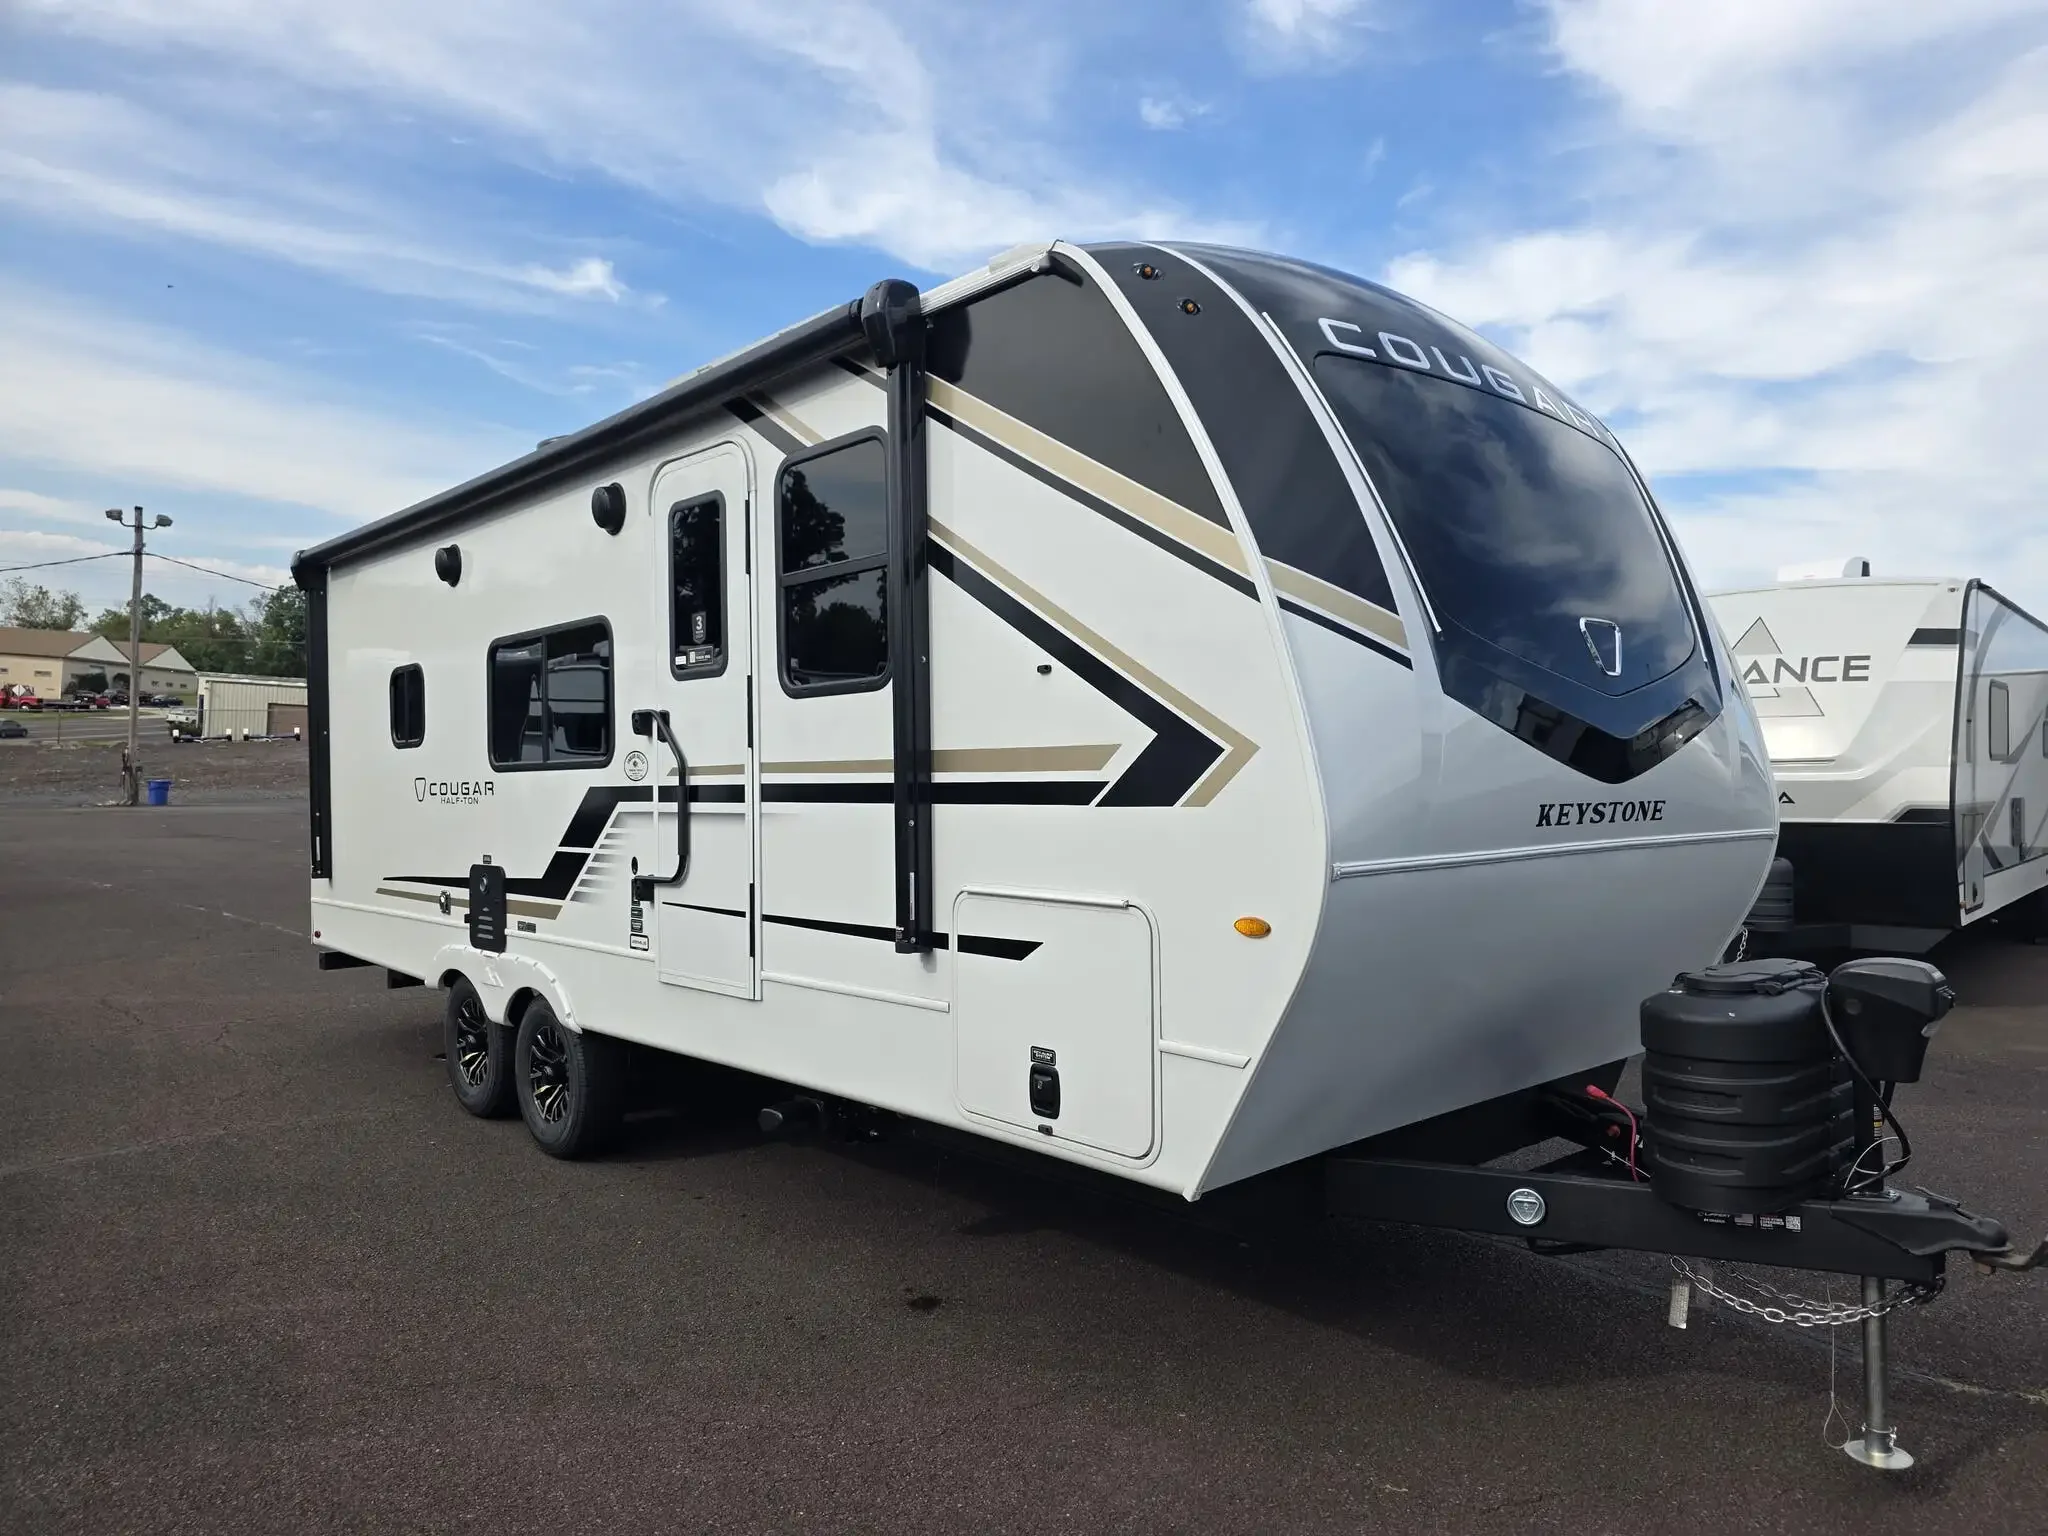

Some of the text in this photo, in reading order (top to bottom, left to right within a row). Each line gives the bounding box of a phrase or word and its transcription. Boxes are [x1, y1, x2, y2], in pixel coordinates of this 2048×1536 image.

[1317, 317, 1601, 439] COUGAR
[429, 781, 495, 796] COUGAR
[1535, 800, 1666, 828] KEYSTONE
